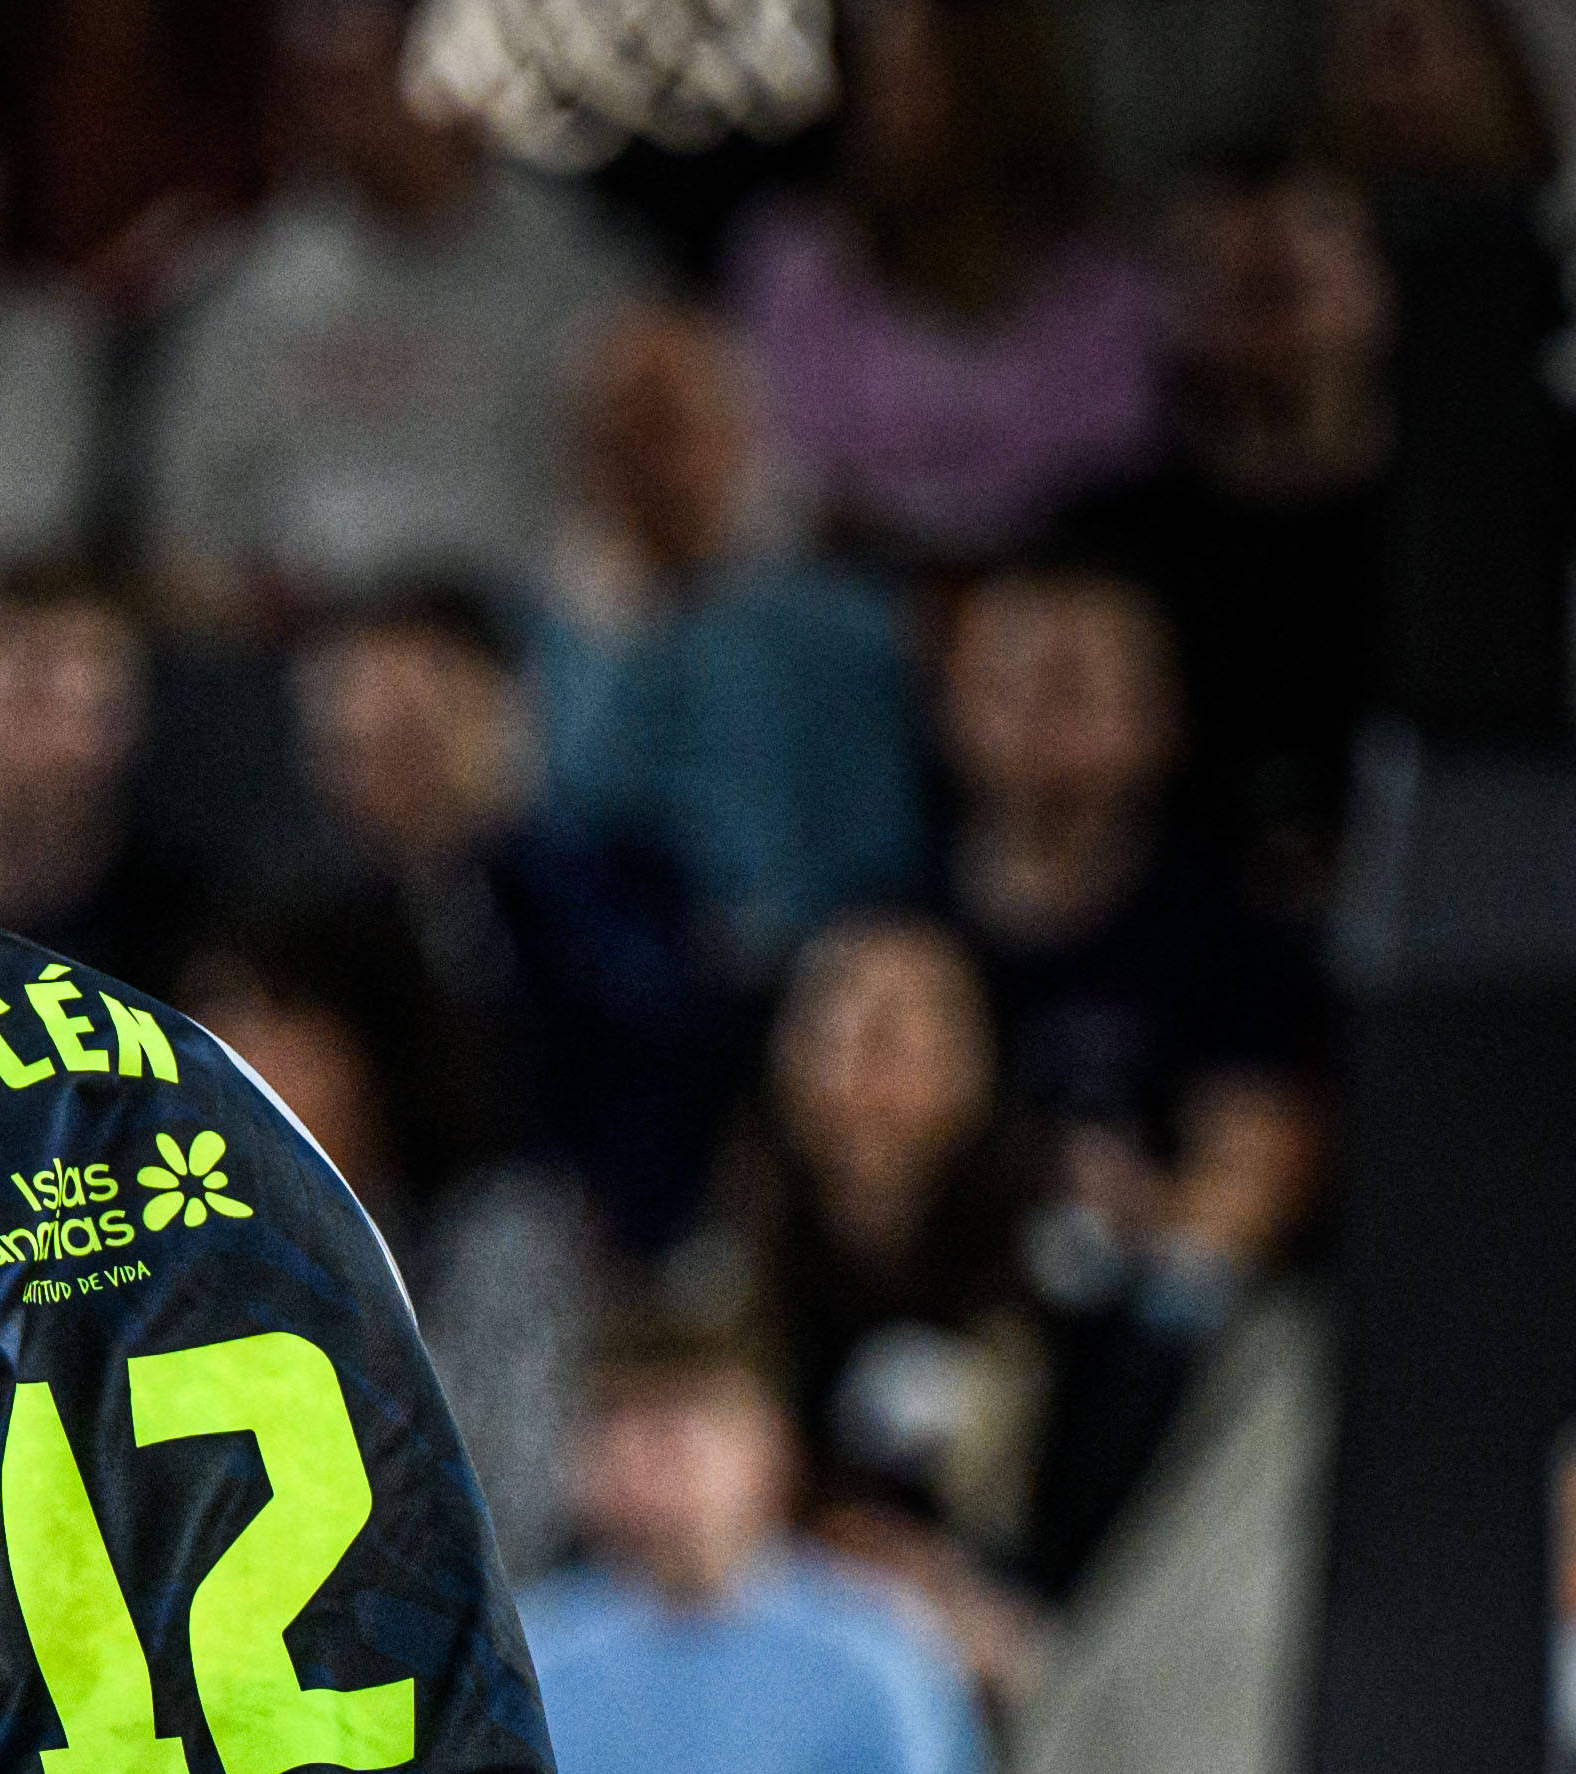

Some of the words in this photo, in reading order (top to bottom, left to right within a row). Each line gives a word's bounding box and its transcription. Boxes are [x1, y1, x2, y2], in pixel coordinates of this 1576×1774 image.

[11, 1158, 118, 1211] Islas
[77, 1272, 103, 1295] DE
[103, 1261, 151, 1287] VIDA
